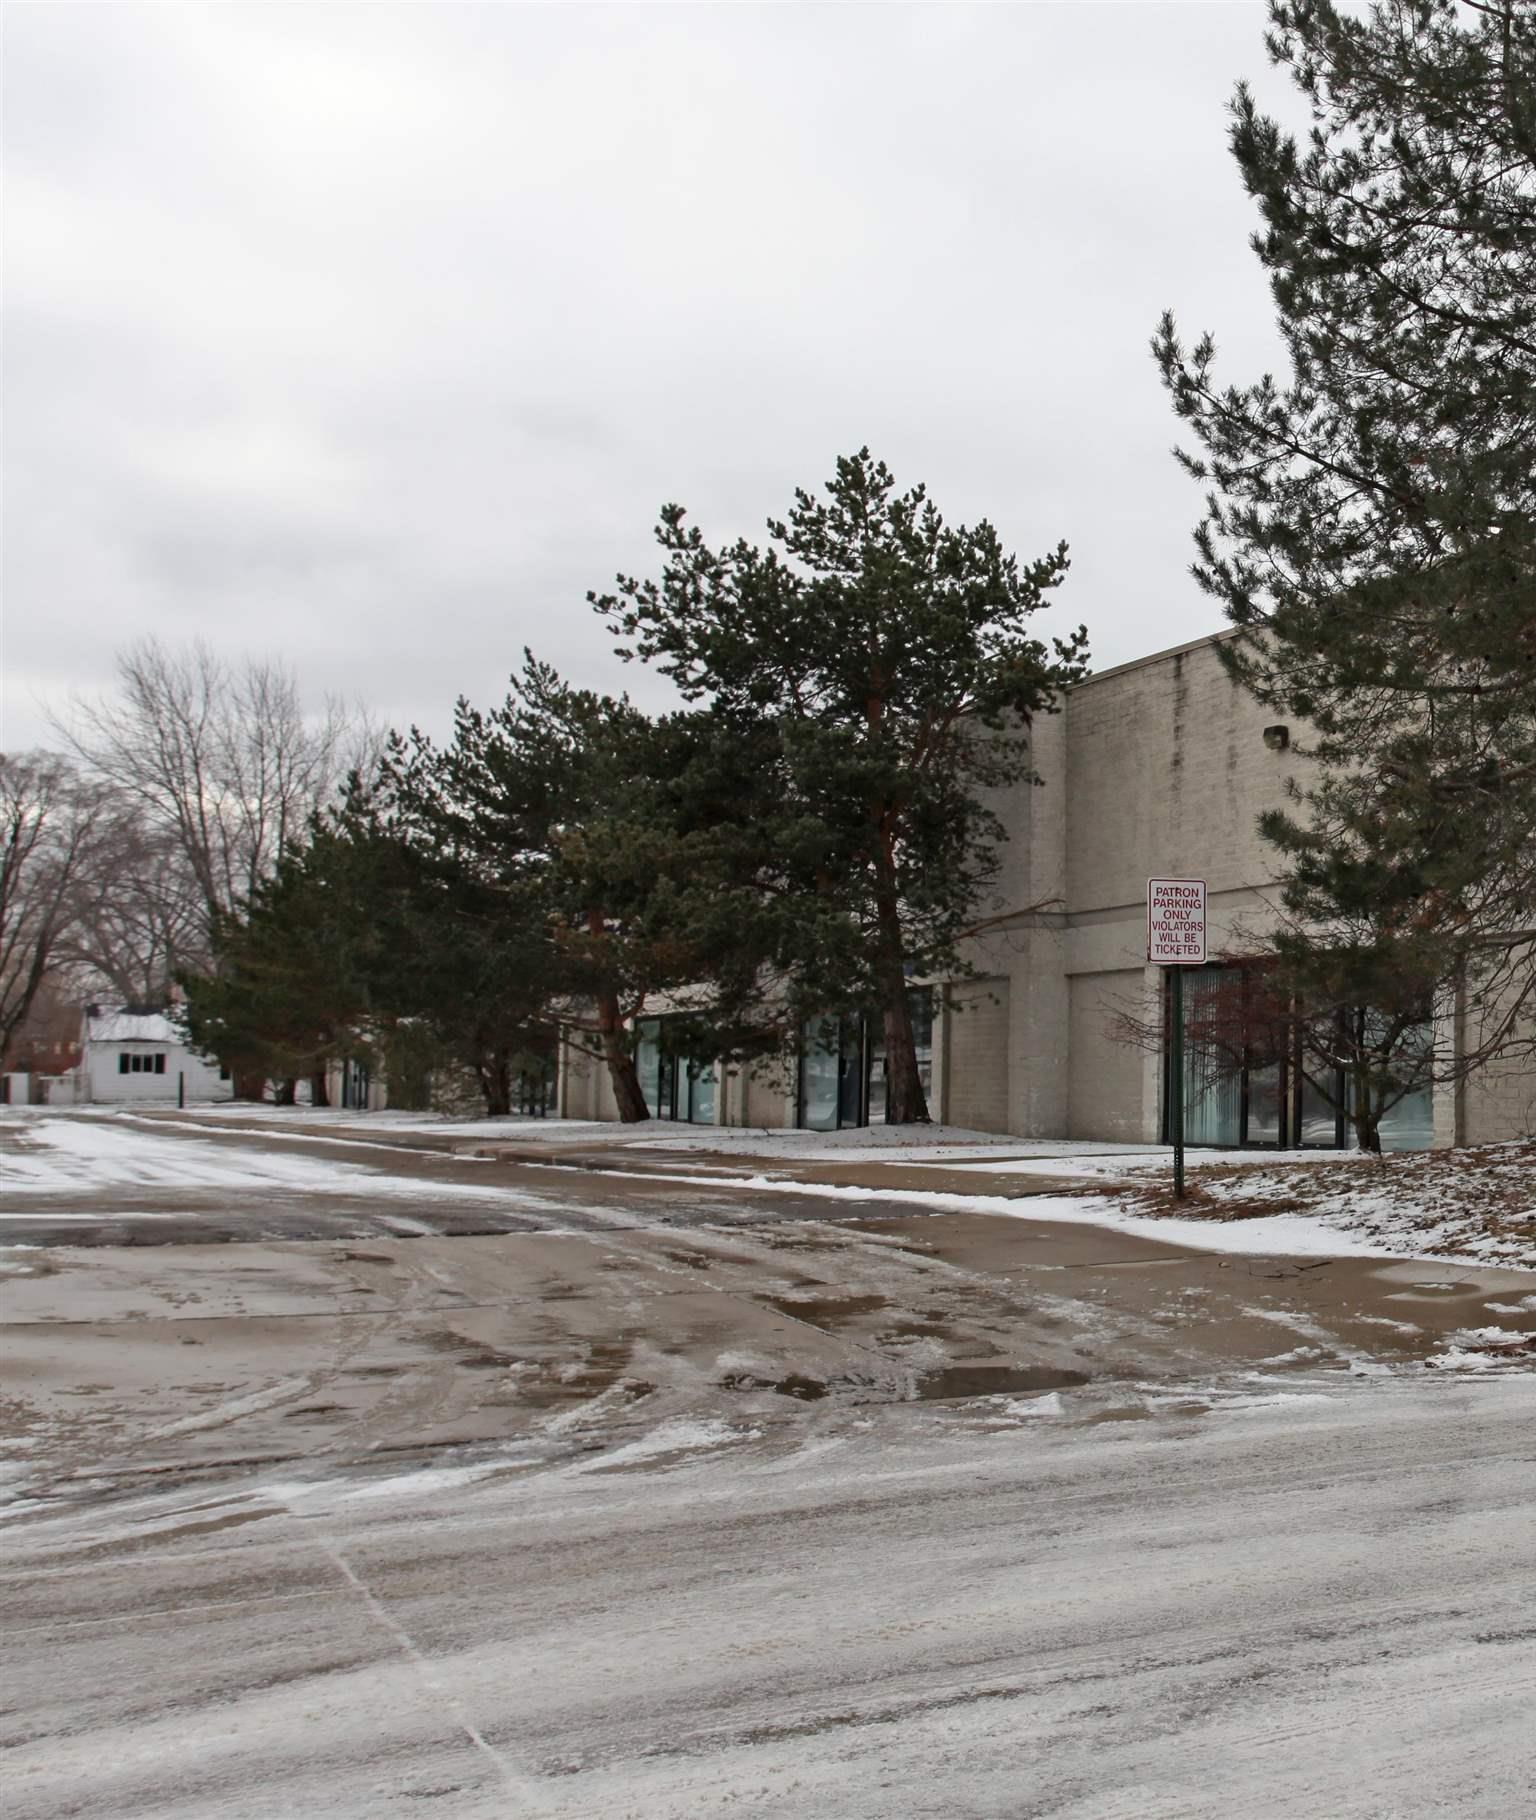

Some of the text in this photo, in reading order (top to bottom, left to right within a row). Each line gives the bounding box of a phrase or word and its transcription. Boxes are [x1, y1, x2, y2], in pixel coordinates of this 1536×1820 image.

[1156, 887, 1199, 897] PATRON
[1153, 899, 1201, 909] PARKING
[1163, 910, 1191, 920] ONLY
[1152, 921, 1203, 931] VIOLATORS
[1159, 933, 1197, 942] WILL BE
[1155, 944, 1200, 954] TICKETED
